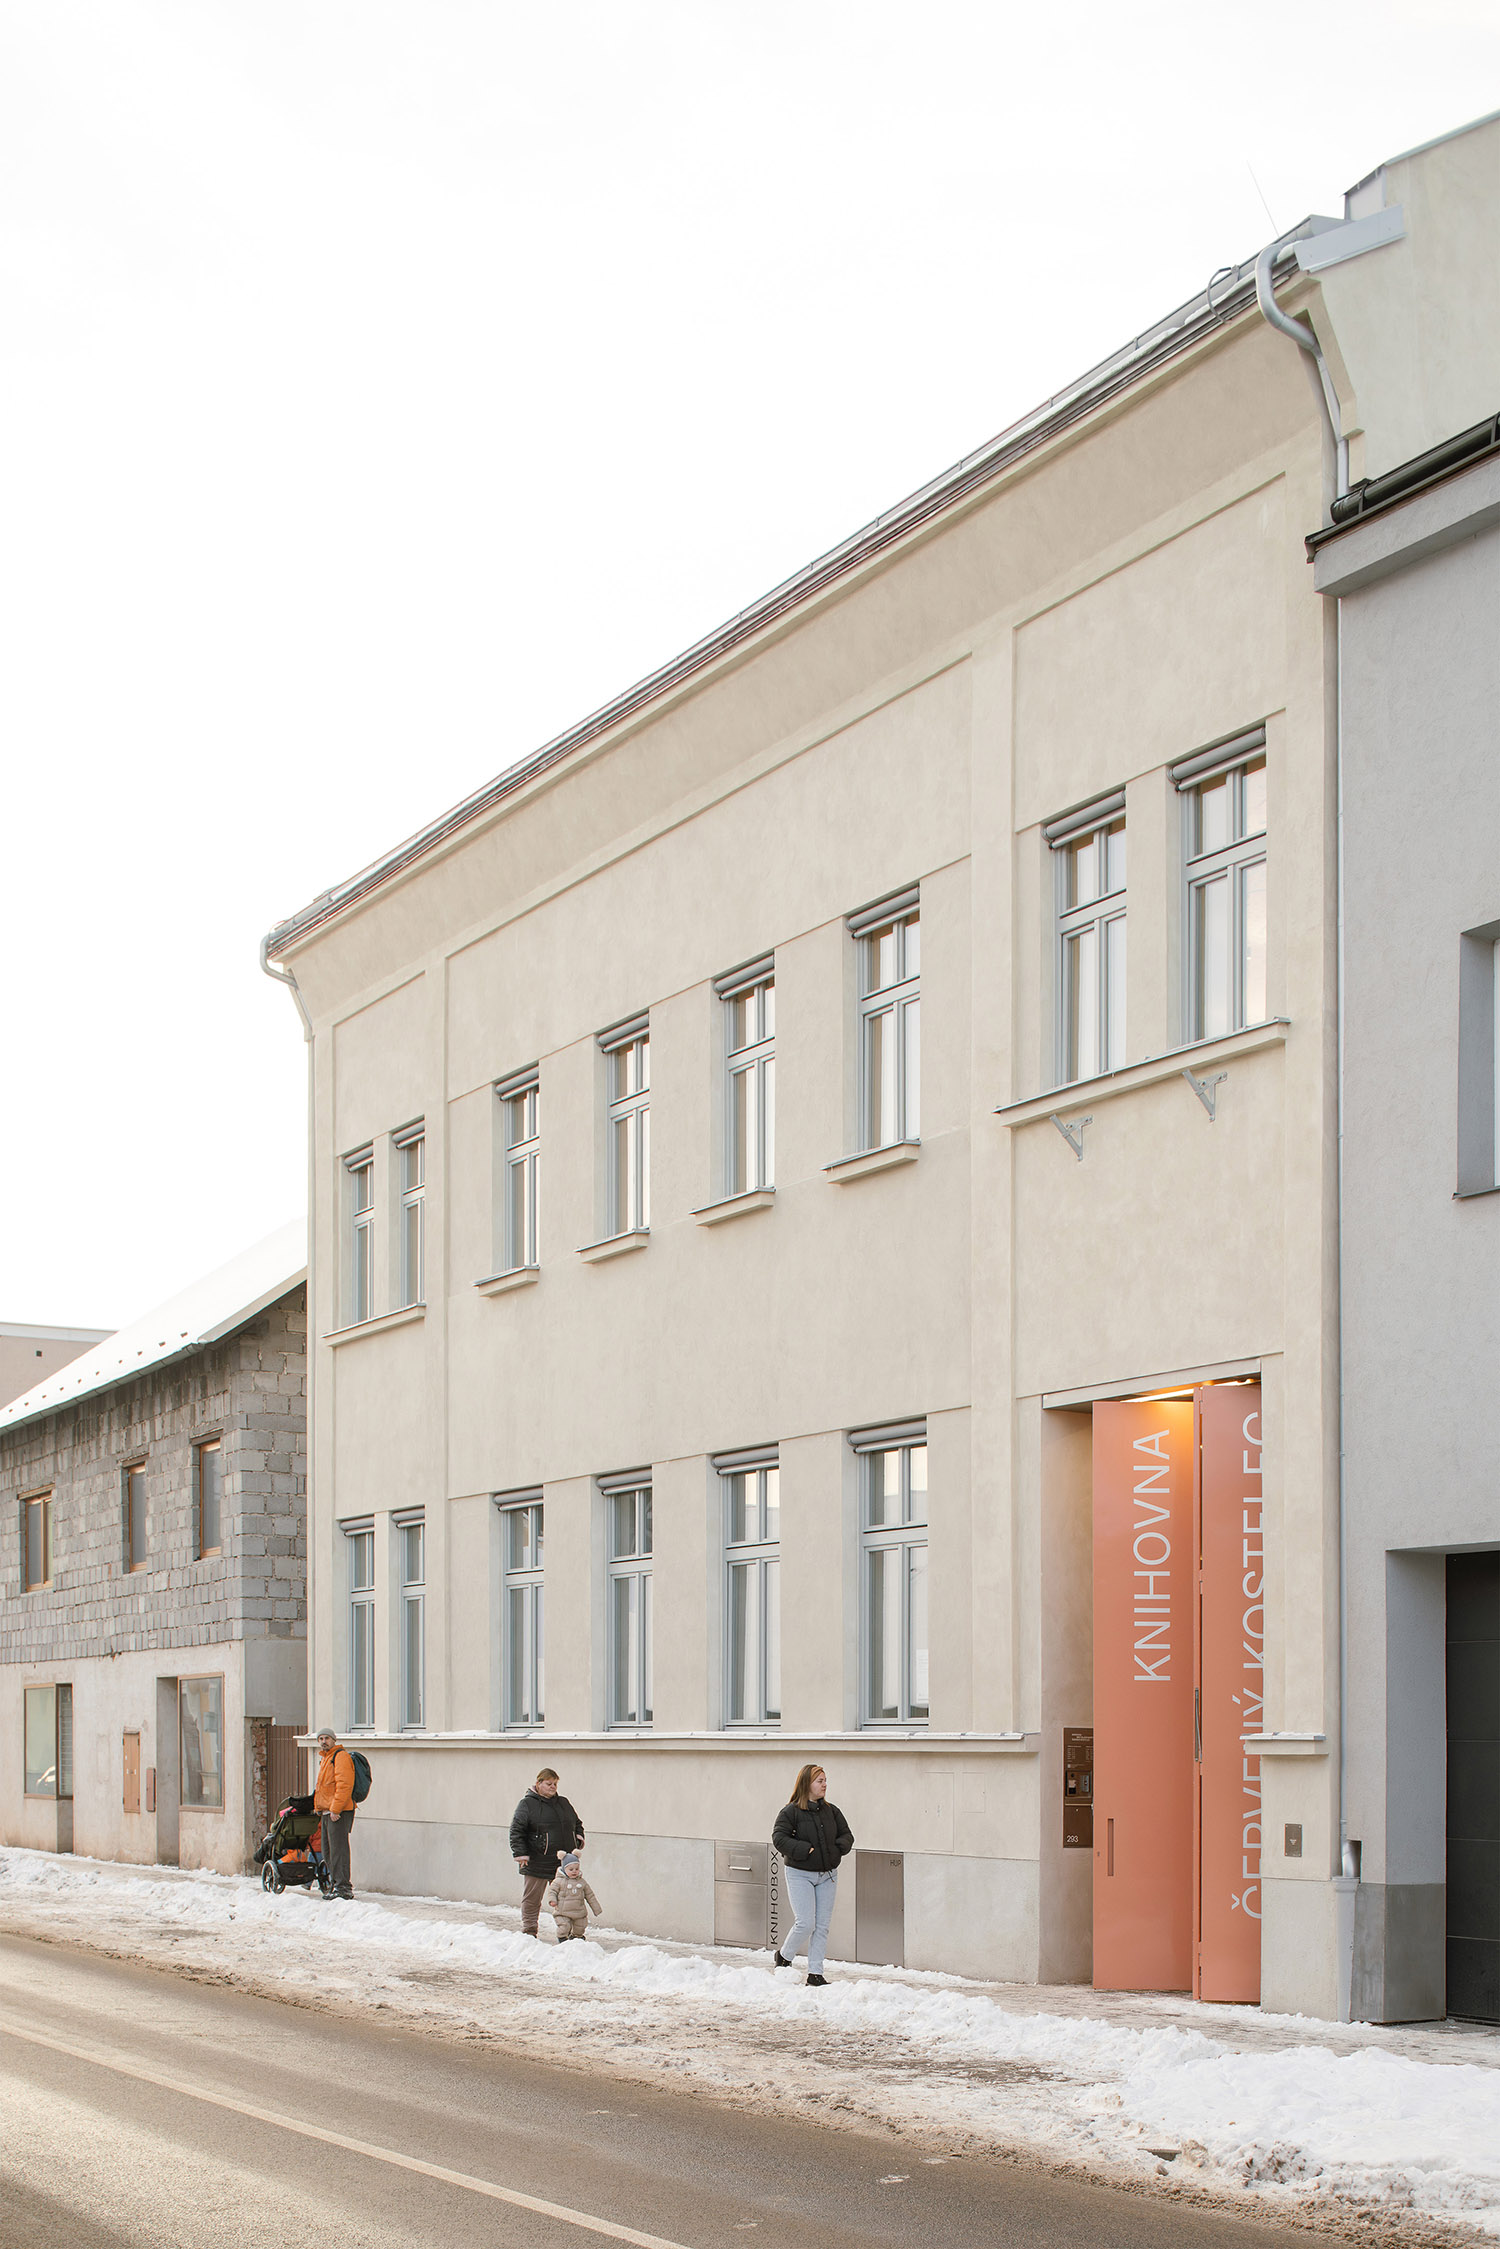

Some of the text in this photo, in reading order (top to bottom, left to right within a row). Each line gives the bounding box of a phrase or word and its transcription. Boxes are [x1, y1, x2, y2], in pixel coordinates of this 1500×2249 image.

[1133, 1429, 1171, 1681] KNIHOVNA
[1066, 1835, 1079, 1843] 293
[1231, 1687, 1264, 1919] ČERVEÝ
[770, 1851, 779, 1945] KNIHOBOX
